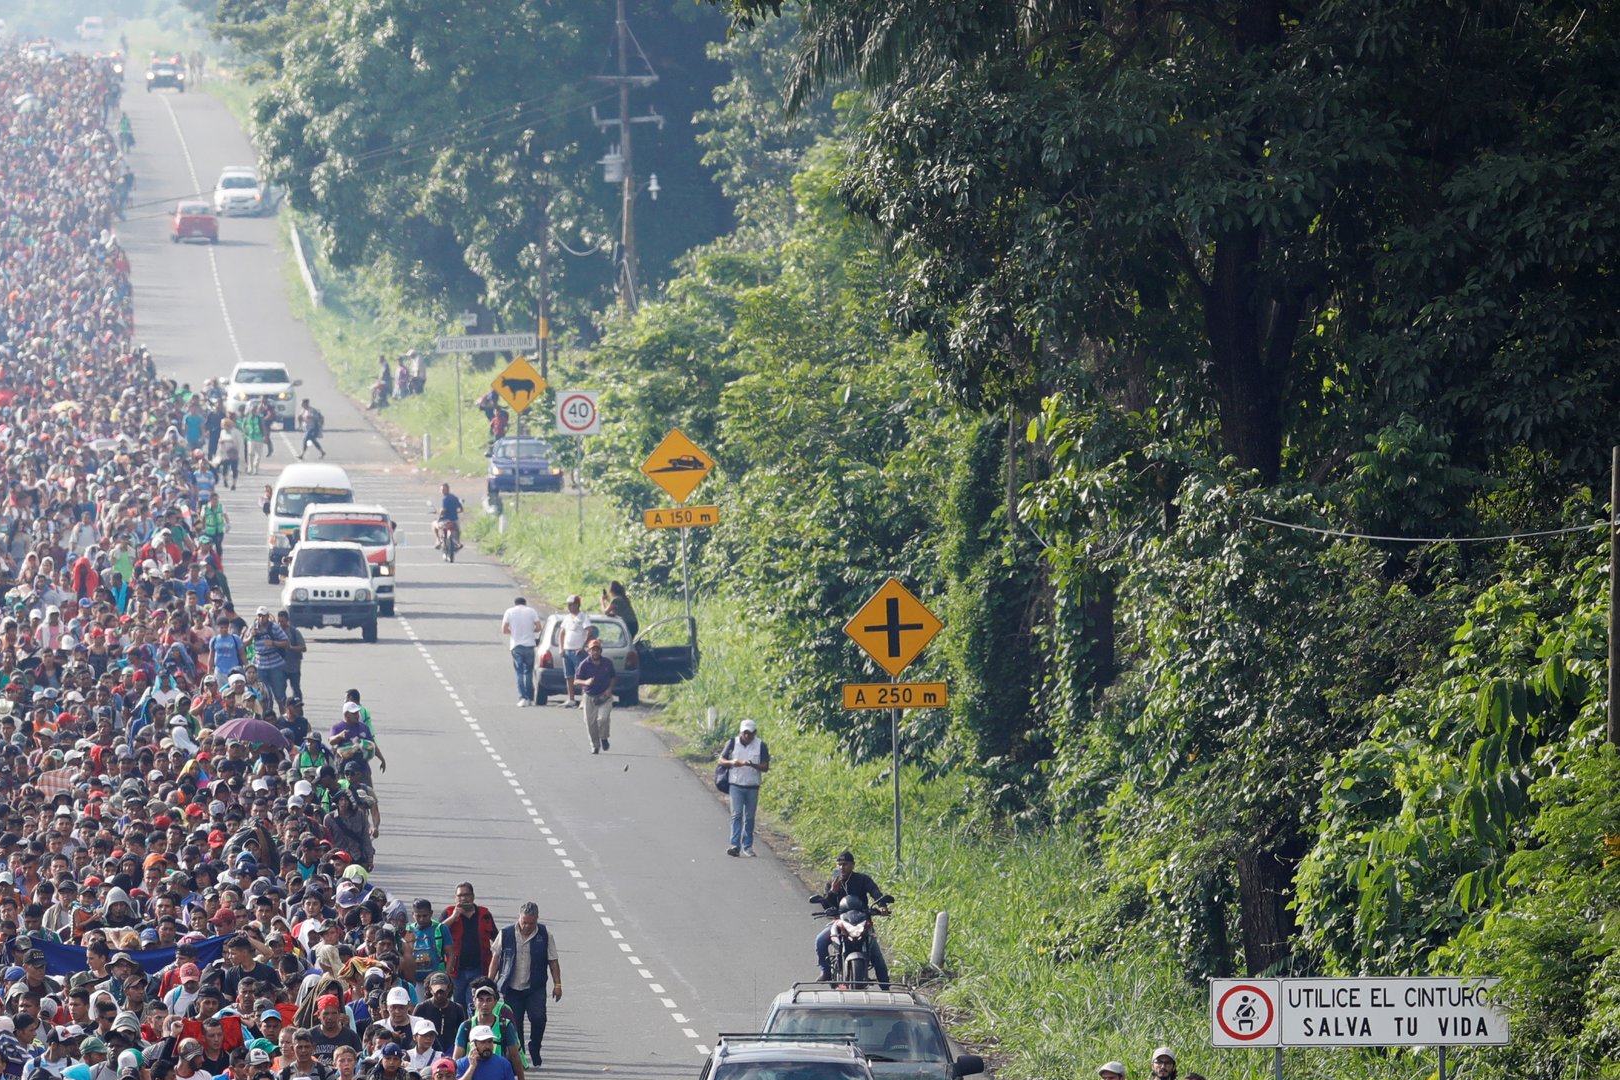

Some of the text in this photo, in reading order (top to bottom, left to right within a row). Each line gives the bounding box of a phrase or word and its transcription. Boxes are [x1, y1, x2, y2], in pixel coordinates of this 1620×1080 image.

[568, 402, 589, 418] 40
[654, 511, 711, 525] A 150 m
[855, 688, 937, 705] A 250 m
[1288, 988, 1361, 1008] UTILICE
[1370, 988, 1395, 1008] EL
[1303, 1017, 1489, 1037] SALVA TU VIDA
